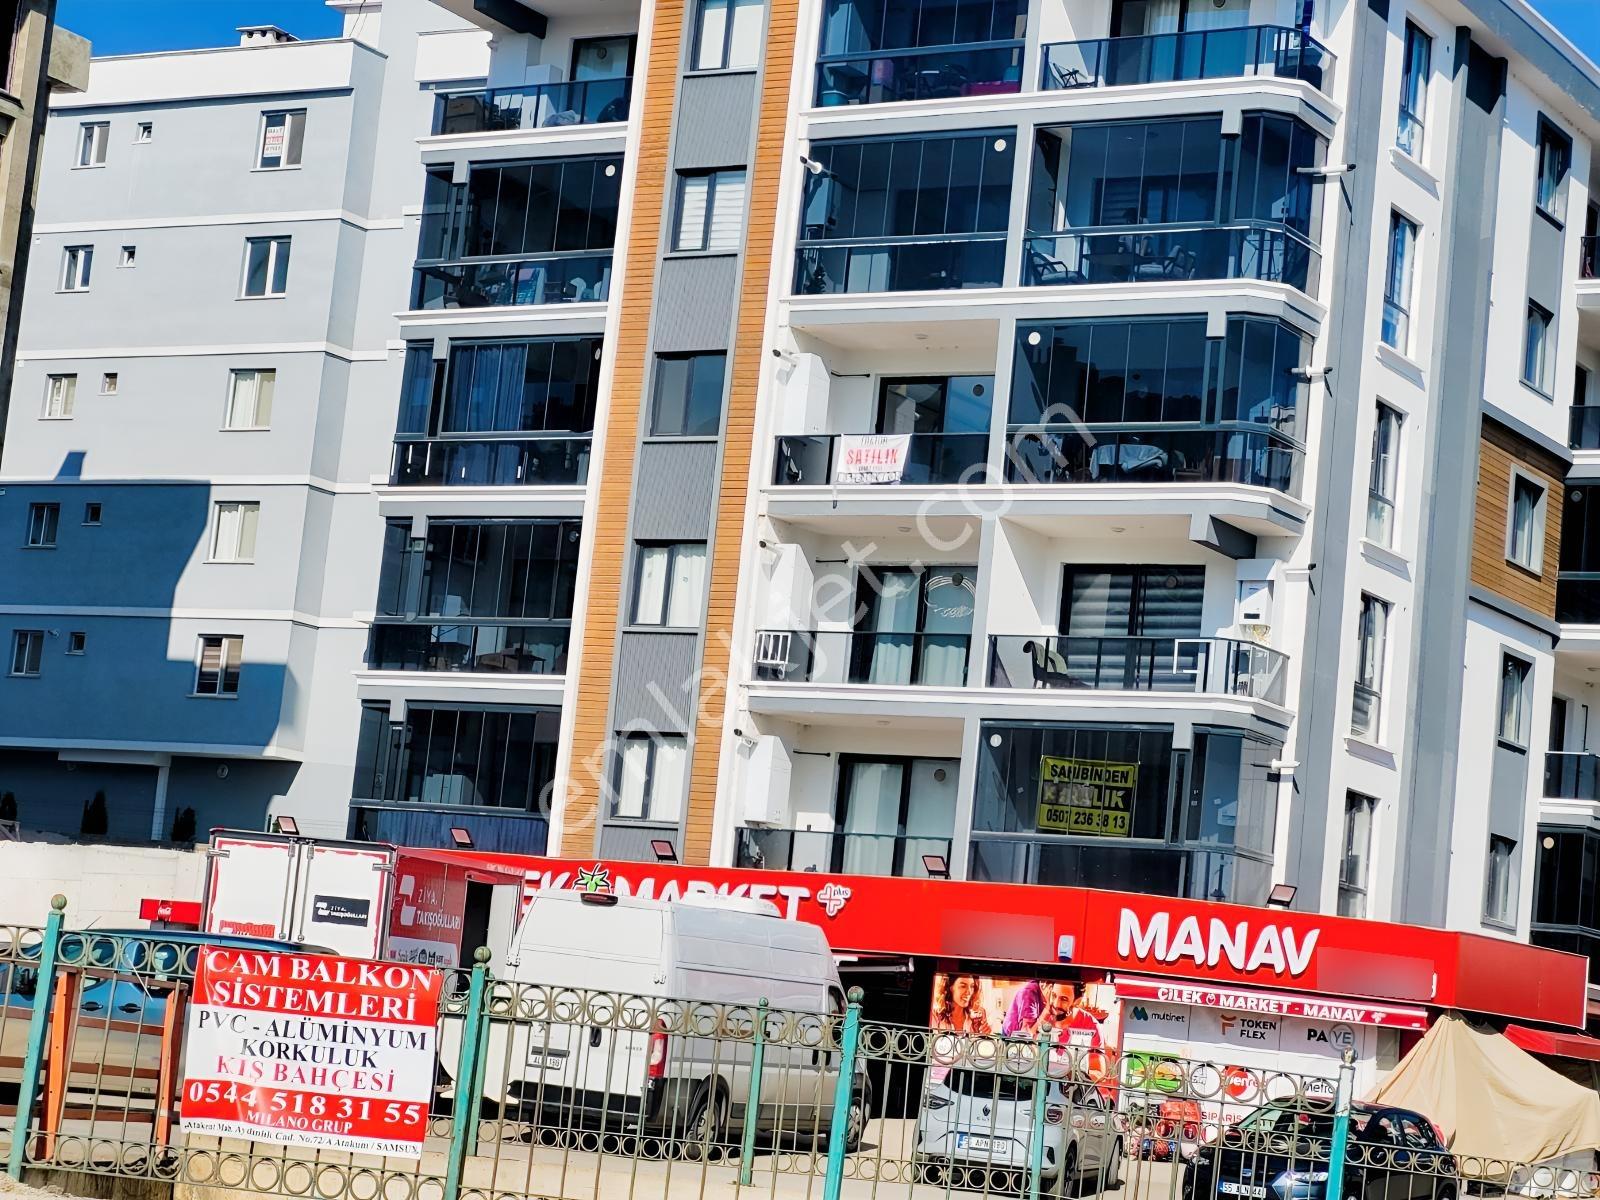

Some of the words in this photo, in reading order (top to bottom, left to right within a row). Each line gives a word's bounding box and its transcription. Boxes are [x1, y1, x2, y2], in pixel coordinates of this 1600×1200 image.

[1074, 812, 1093, 826] 236
[1113, 816, 1126, 829] 13
[833, 887, 849, 897] plus
[1118, 908, 1320, 975] MANAV
[207, 950, 280, 977] CAM
[290, 958, 434, 992] BALKON
[213, 976, 416, 1021] SİSTEMLERİ
[1219, 996, 1292, 1014] MARKET
[1303, 1004, 1365, 1022] MANAV
[198, 1010, 247, 1033] PVC
[265, 1016, 427, 1050] ALÜMİNYUM
[1151, 1012, 1185, 1023] multinet
[1240, 1018, 1277, 1031] TOKEN
[1240, 1029, 1266, 1040] FLEX
[240, 1038, 378, 1069] KORKULUK
[216, 1055, 264, 1082] KIŞ
[273, 1061, 395, 1093] BAHÇESİ
[189, 1082, 257, 1107] 0544
[270, 1092, 326, 1116] 518
[336, 1099, 370, 1120] 31
[384, 1103, 421, 1125] 55
[312, 1117, 353, 1134] GRUP
